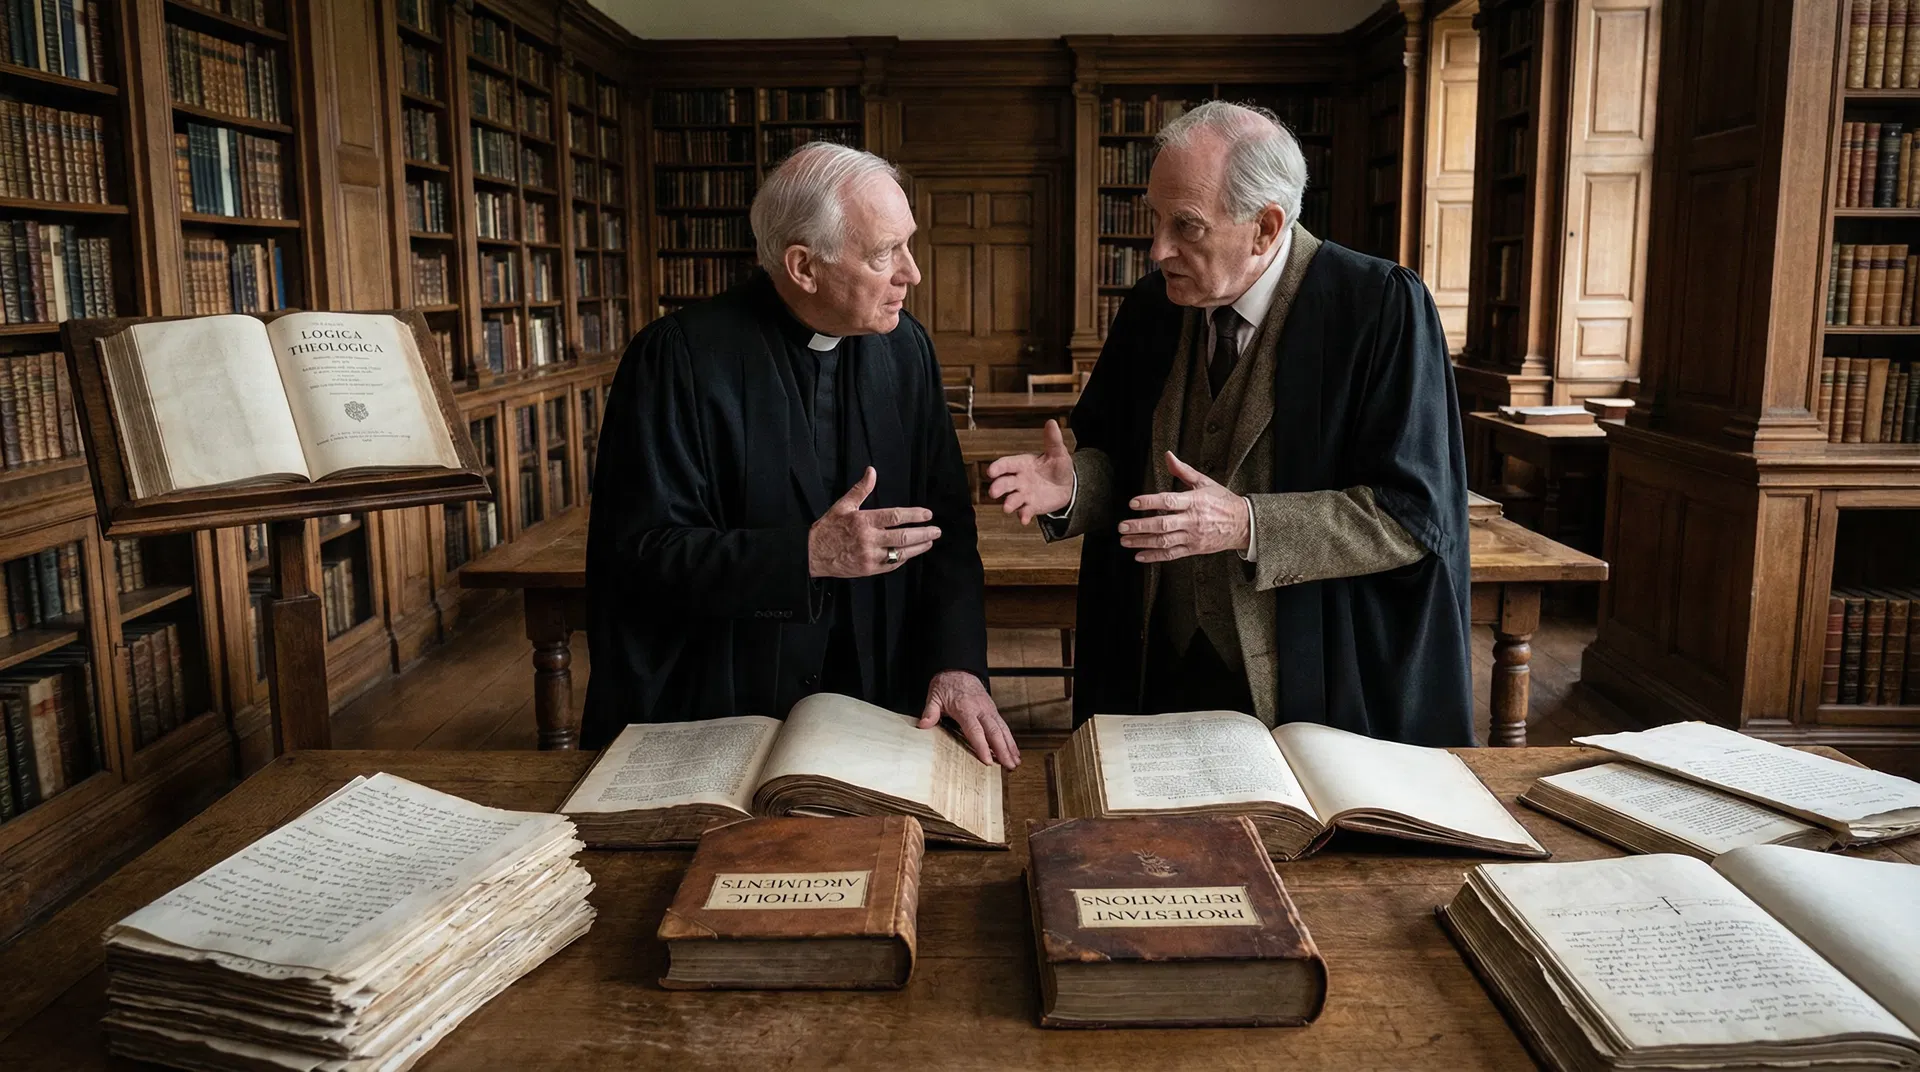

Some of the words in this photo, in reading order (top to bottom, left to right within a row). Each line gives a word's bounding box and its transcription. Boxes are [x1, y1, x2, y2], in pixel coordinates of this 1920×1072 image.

[301, 329, 363, 340] LOGICA
[288, 342, 384, 356] THEOLOGICA
[720, 877, 861, 889] ARGUMENTS
[726, 892, 845, 903] CATHOLIC
[1081, 893, 1242, 906] REFUTATIONS
[1093, 909, 1245, 921] PROTESTANT
